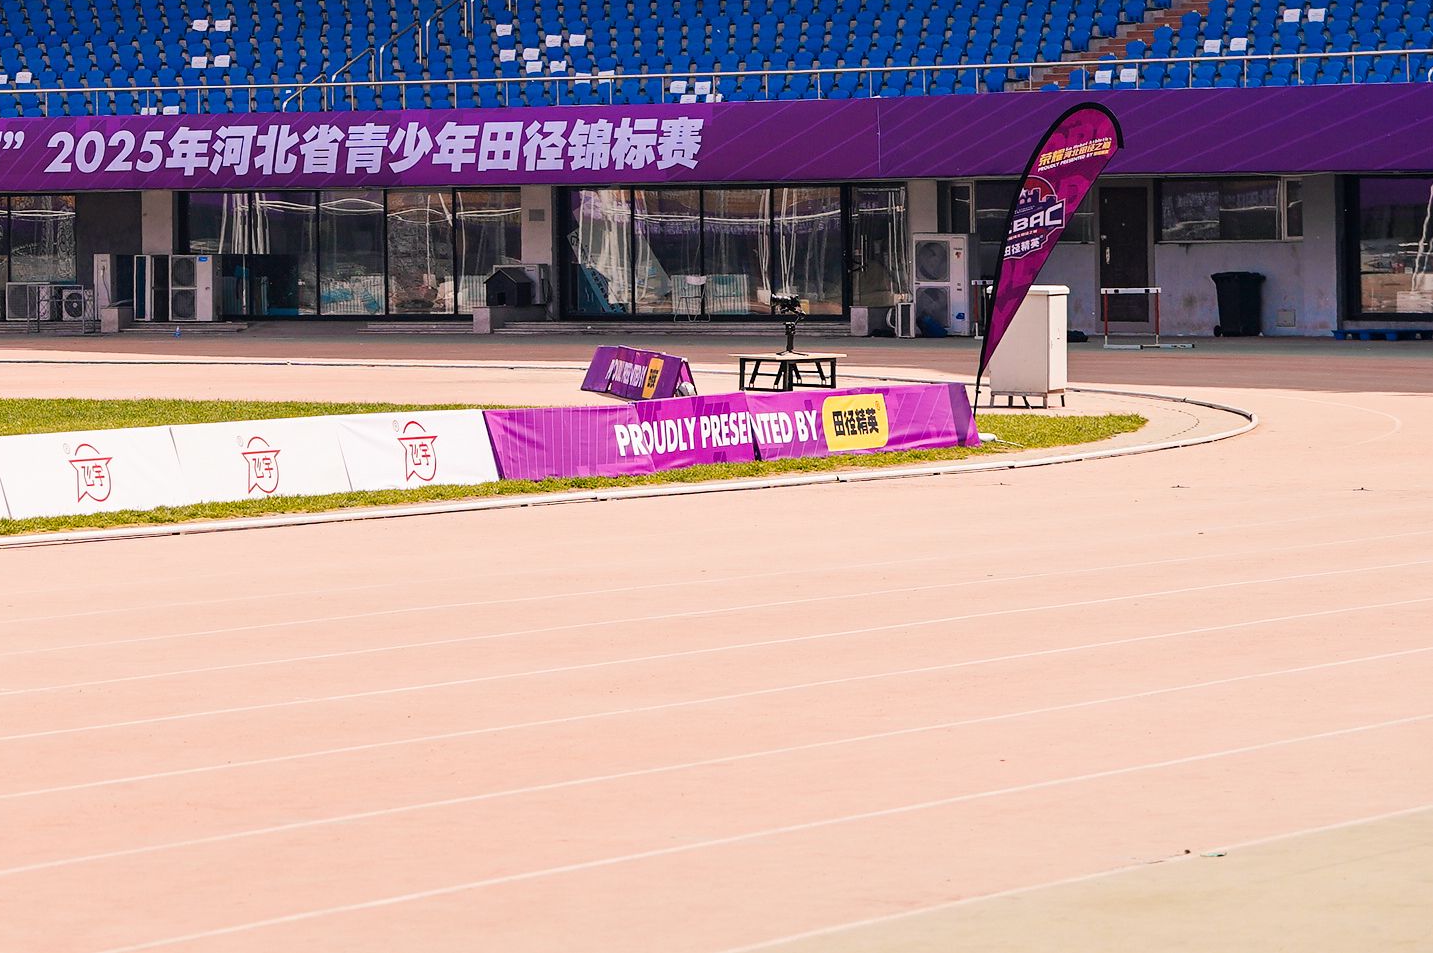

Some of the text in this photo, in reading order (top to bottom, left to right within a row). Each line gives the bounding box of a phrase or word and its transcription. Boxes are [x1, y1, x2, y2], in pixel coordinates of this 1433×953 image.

[44, 118, 705, 178] 2025年河北省青少年田径锦标赛
[614, 409, 817, 457] PROUDLY PRESENTED BY
[832, 406, 880, 437] 田径精英
